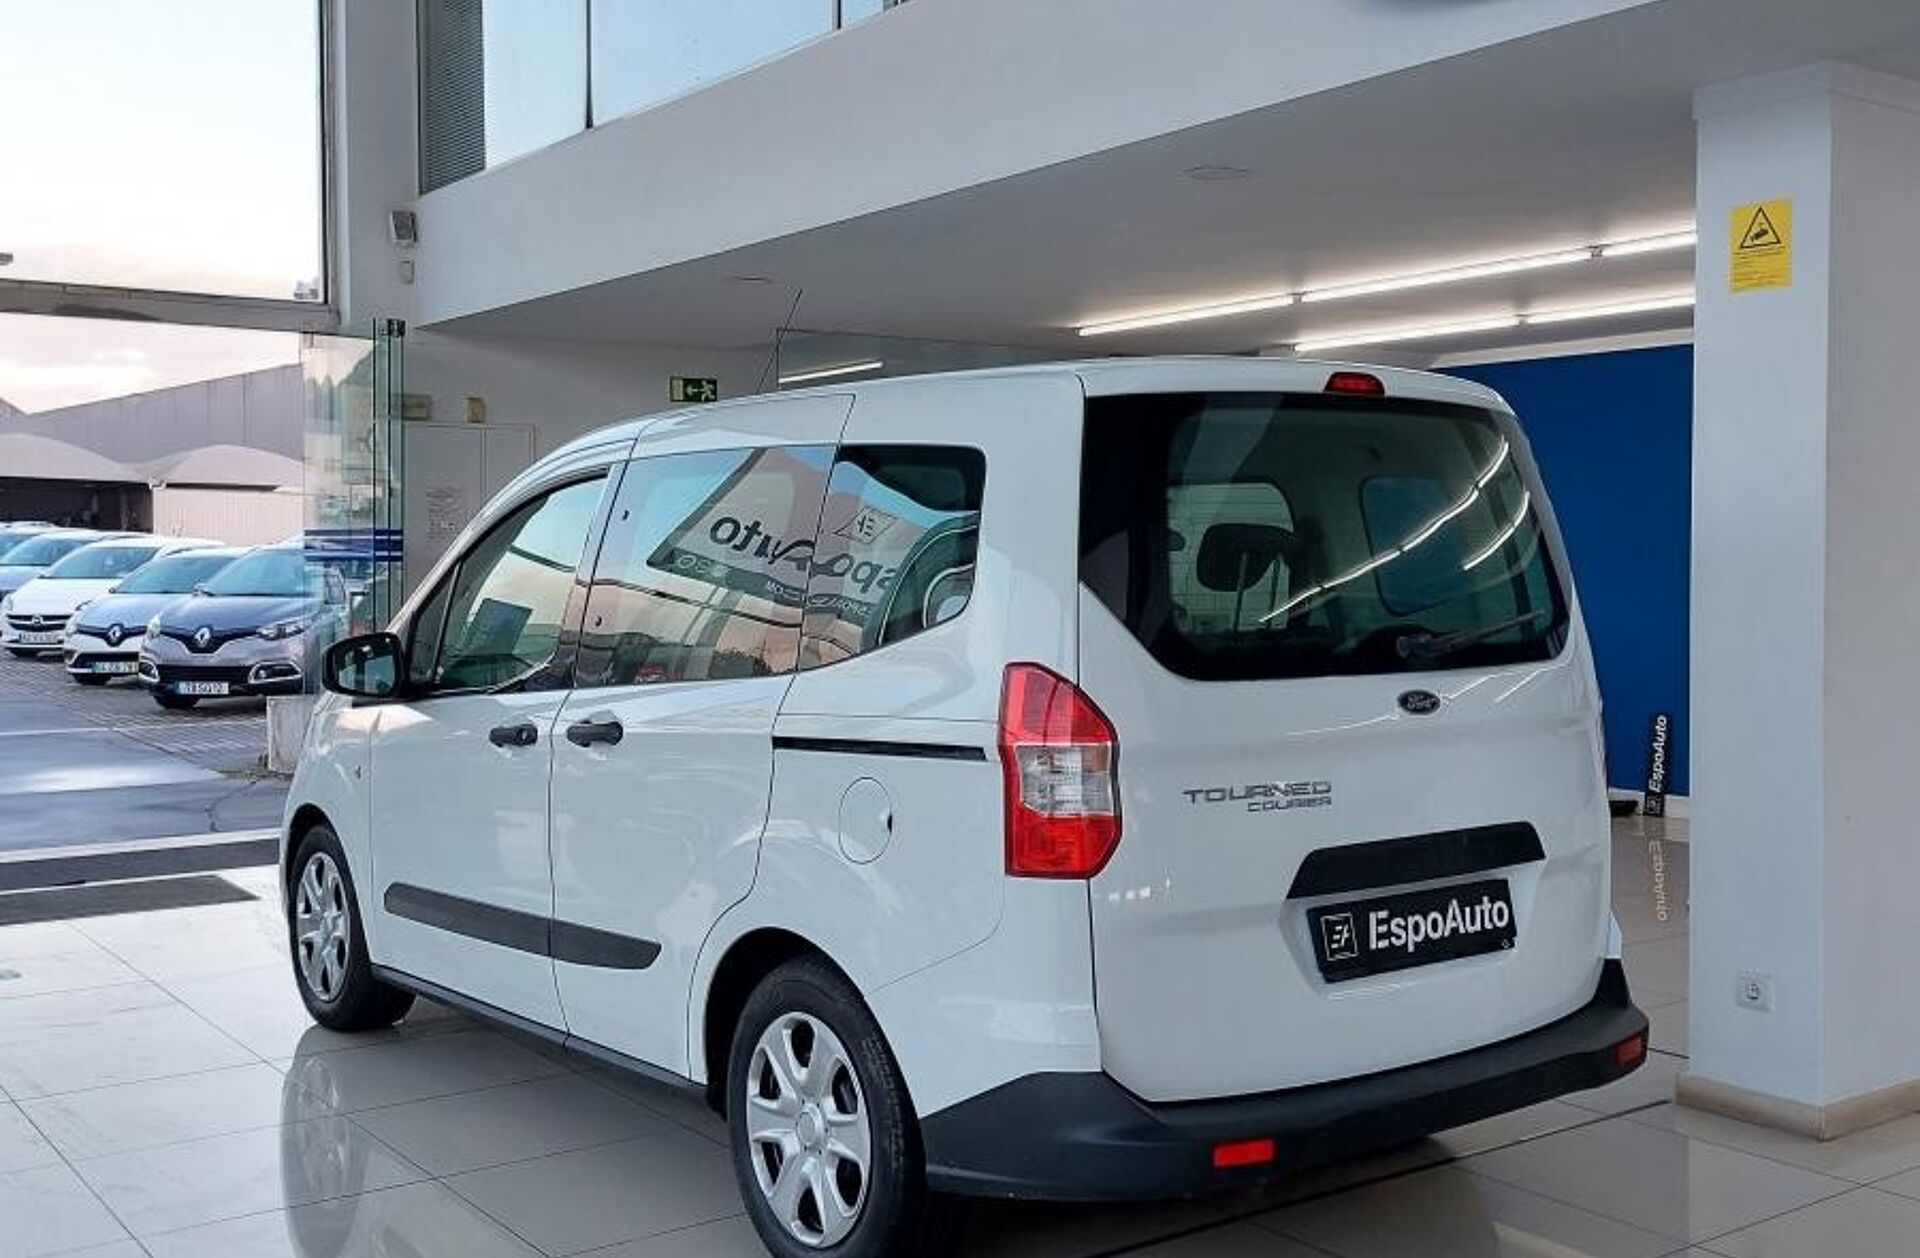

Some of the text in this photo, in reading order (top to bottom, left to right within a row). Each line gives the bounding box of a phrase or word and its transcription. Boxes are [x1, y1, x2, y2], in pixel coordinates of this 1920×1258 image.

[1648, 714, 1667, 793] EspoAuto
[1247, 796, 1332, 812] COURIER
[1369, 896, 1509, 952] EspoAuto
